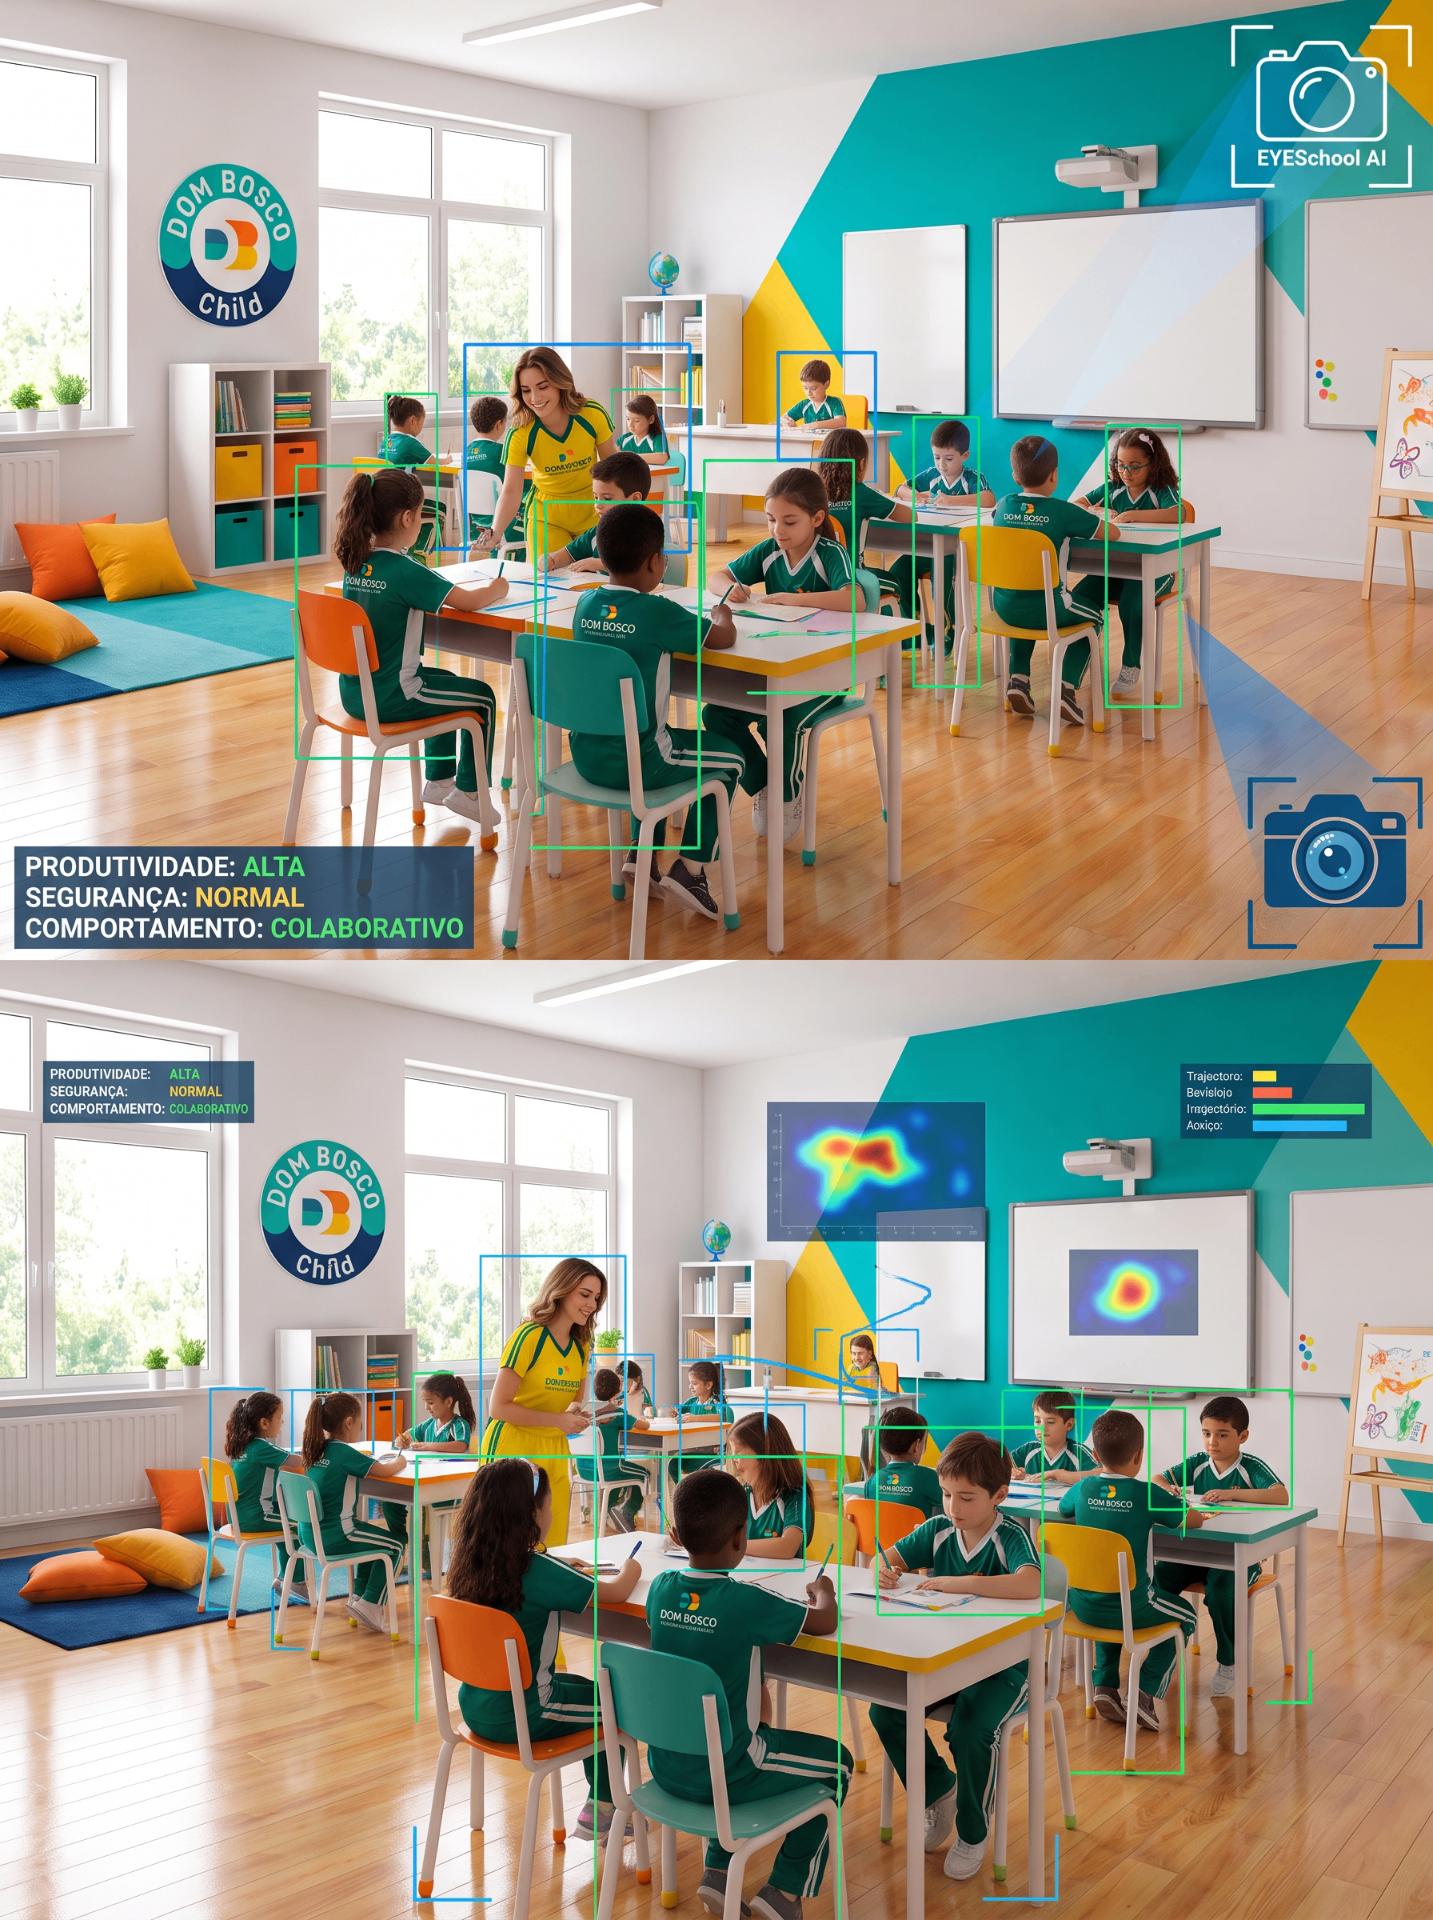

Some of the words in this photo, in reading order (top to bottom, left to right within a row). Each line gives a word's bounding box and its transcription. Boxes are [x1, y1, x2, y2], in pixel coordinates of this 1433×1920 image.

[166, 176, 213, 239] DOM
[221, 169, 291, 241] BOSCO
[198, 291, 264, 320] Child
[1003, 513, 1021, 521] DOM
[1023, 514, 1050, 523] BOSCO
[361, 578, 387, 590] BOSCO
[580, 618, 601, 630] DOM
[602, 621, 636, 634] BOSCO
[266, 1150, 311, 1208] DOM
[317, 1145, 380, 1209] BOSCO
[891, 1485, 914, 1493] BOSCO
[1087, 1498, 1105, 1506] DOM
[1106, 1500, 1133, 1508] BOSCO
[660, 1609, 682, 1622] DOM
[683, 1613, 718, 1628] BOSCO
